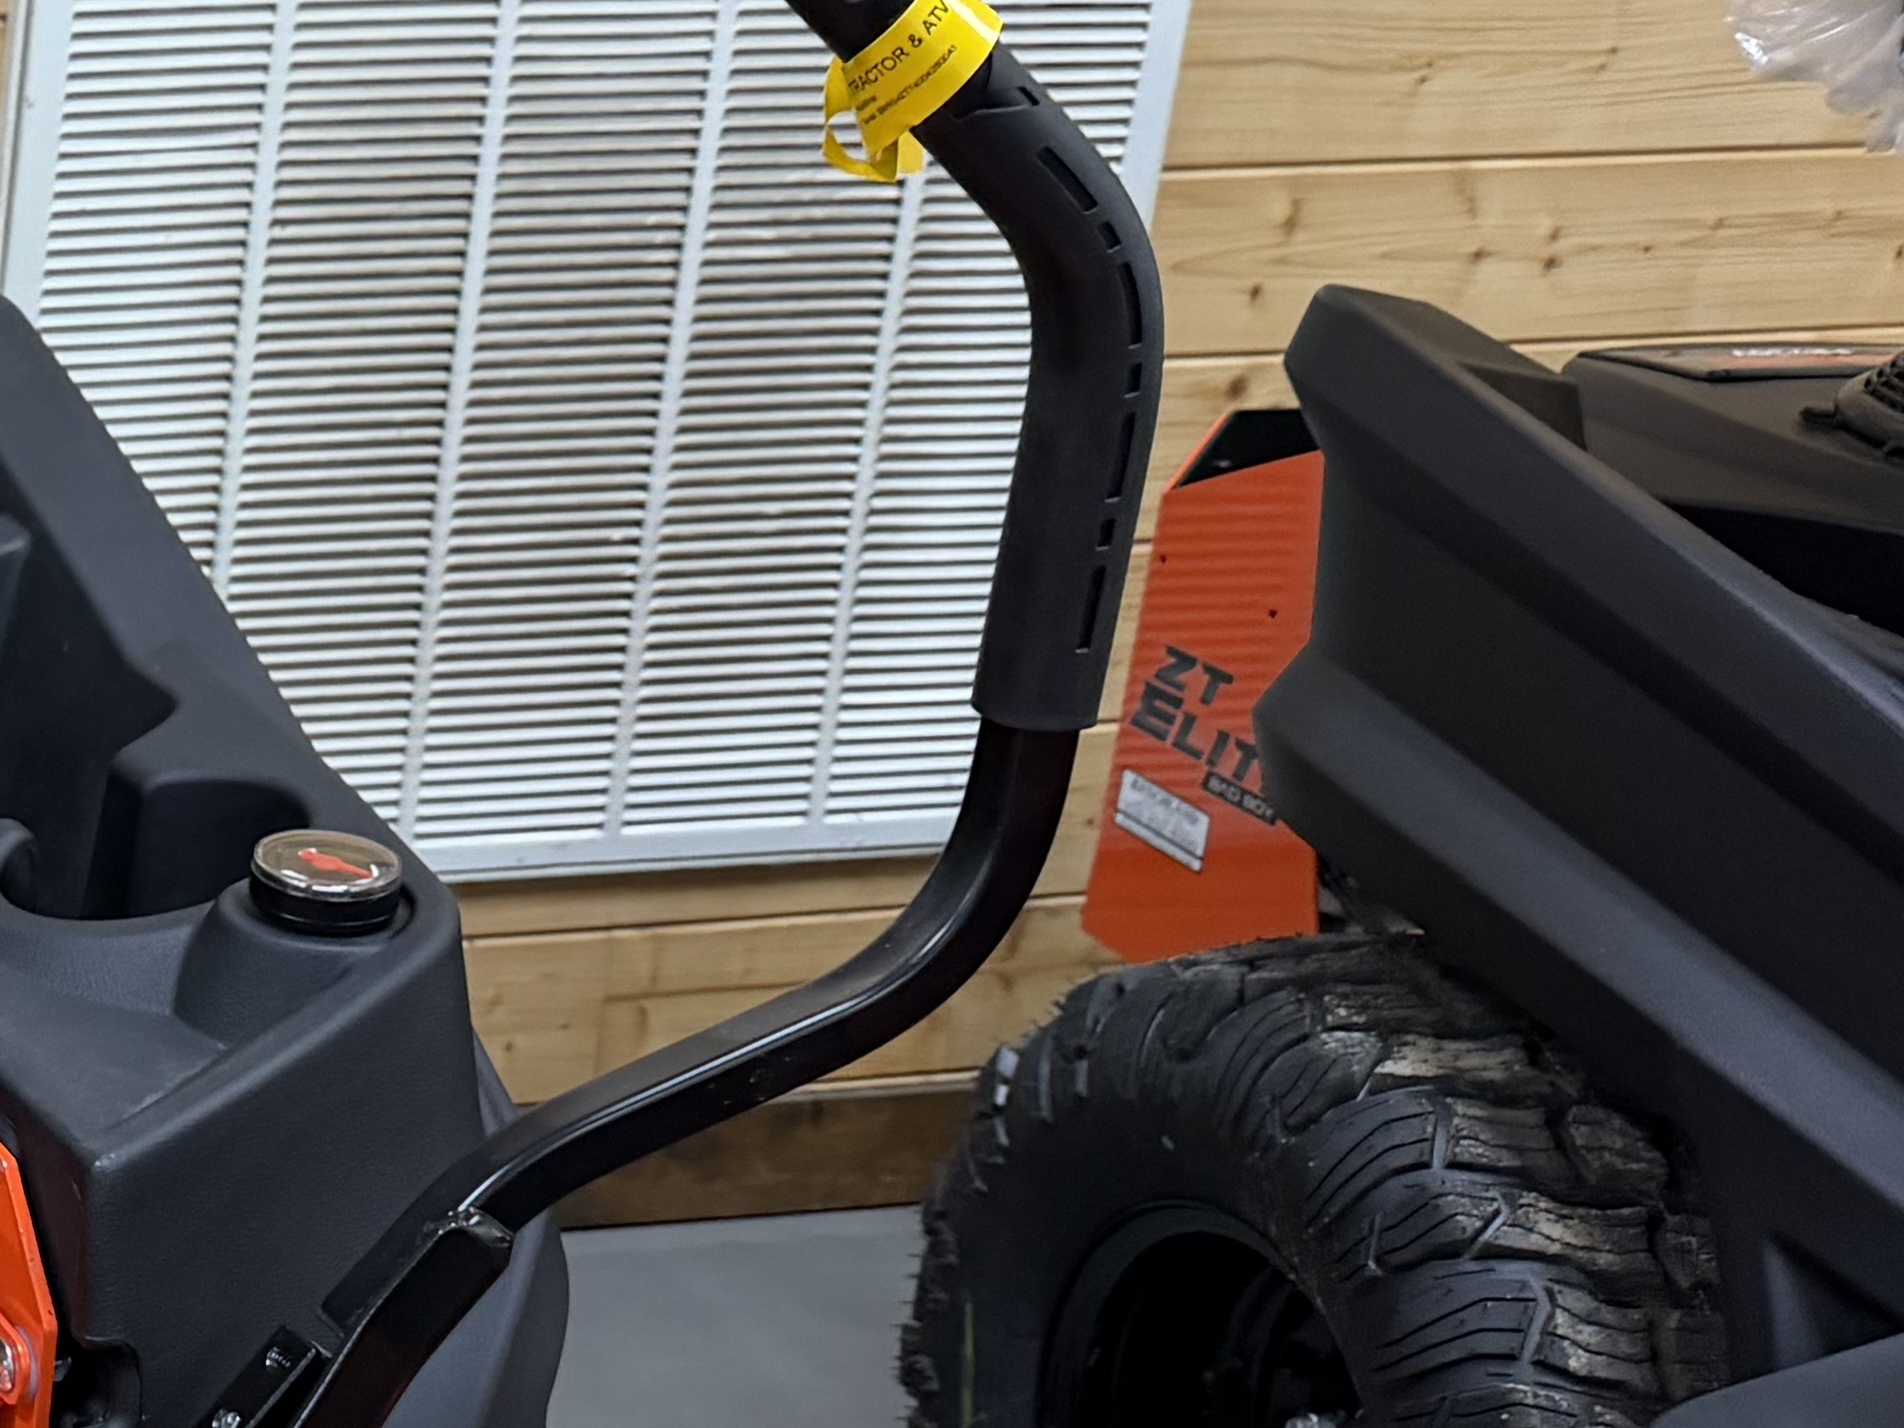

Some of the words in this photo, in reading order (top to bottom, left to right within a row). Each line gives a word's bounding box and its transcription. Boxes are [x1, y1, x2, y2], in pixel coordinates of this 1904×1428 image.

[909, 34, 922, 48] &
[1150, 645, 1236, 706] ZT
[1129, 681, 1264, 795] ELIT
